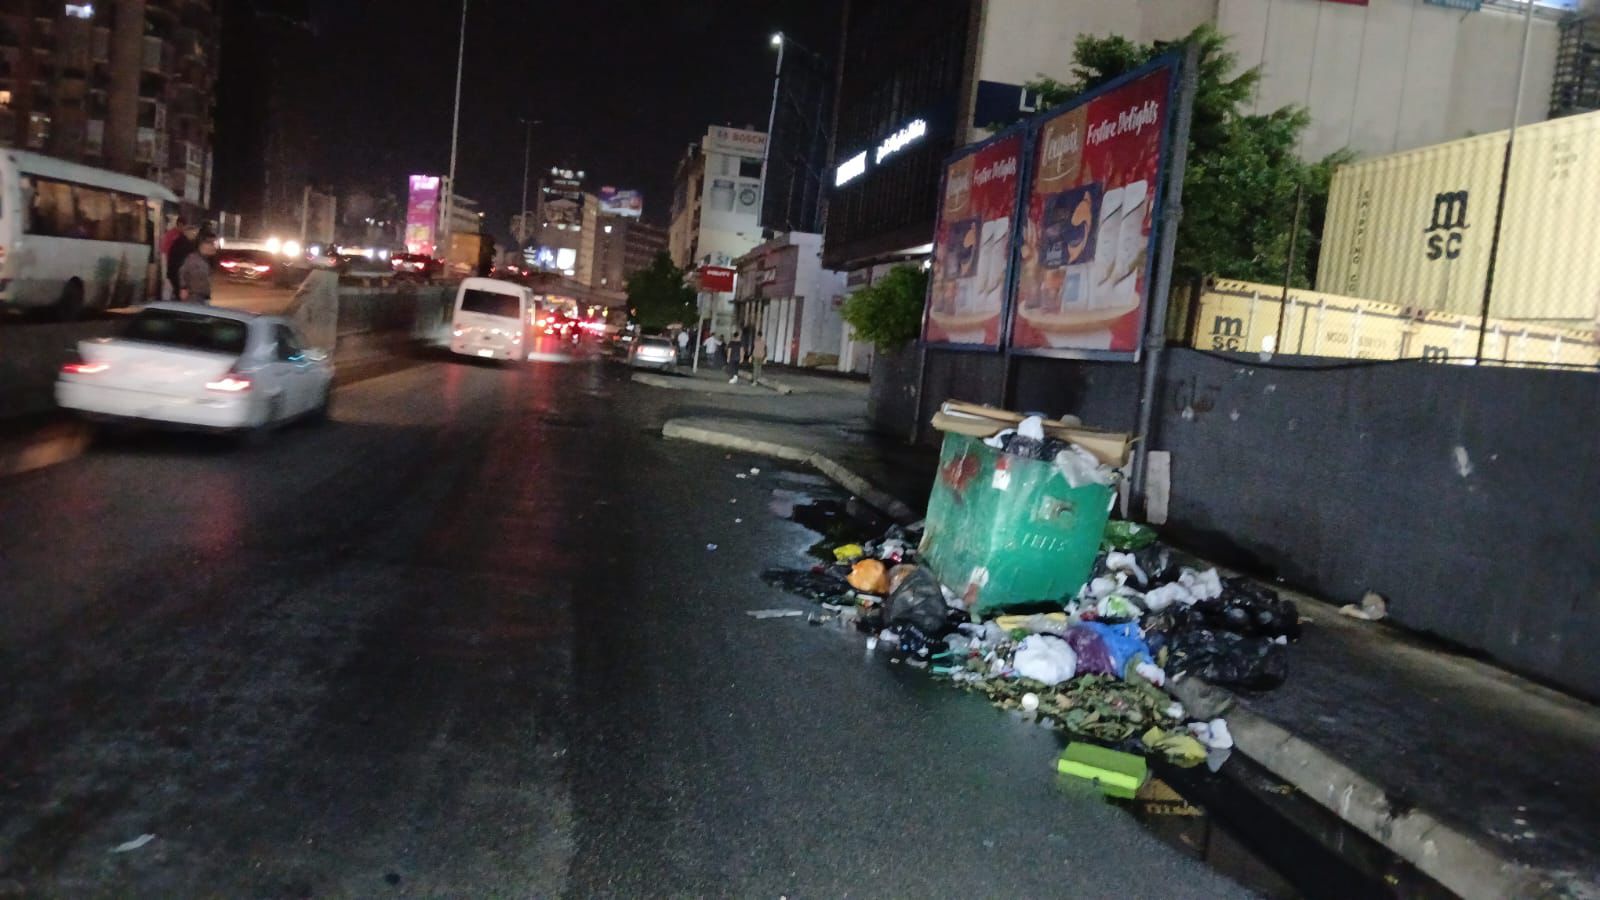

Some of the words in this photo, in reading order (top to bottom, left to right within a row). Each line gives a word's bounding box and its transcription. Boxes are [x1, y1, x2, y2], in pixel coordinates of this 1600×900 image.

[1087, 121, 1117, 146] Festive
[1117, 100, 1159, 136] Delights
[732, 132, 766, 144] BOSCH
